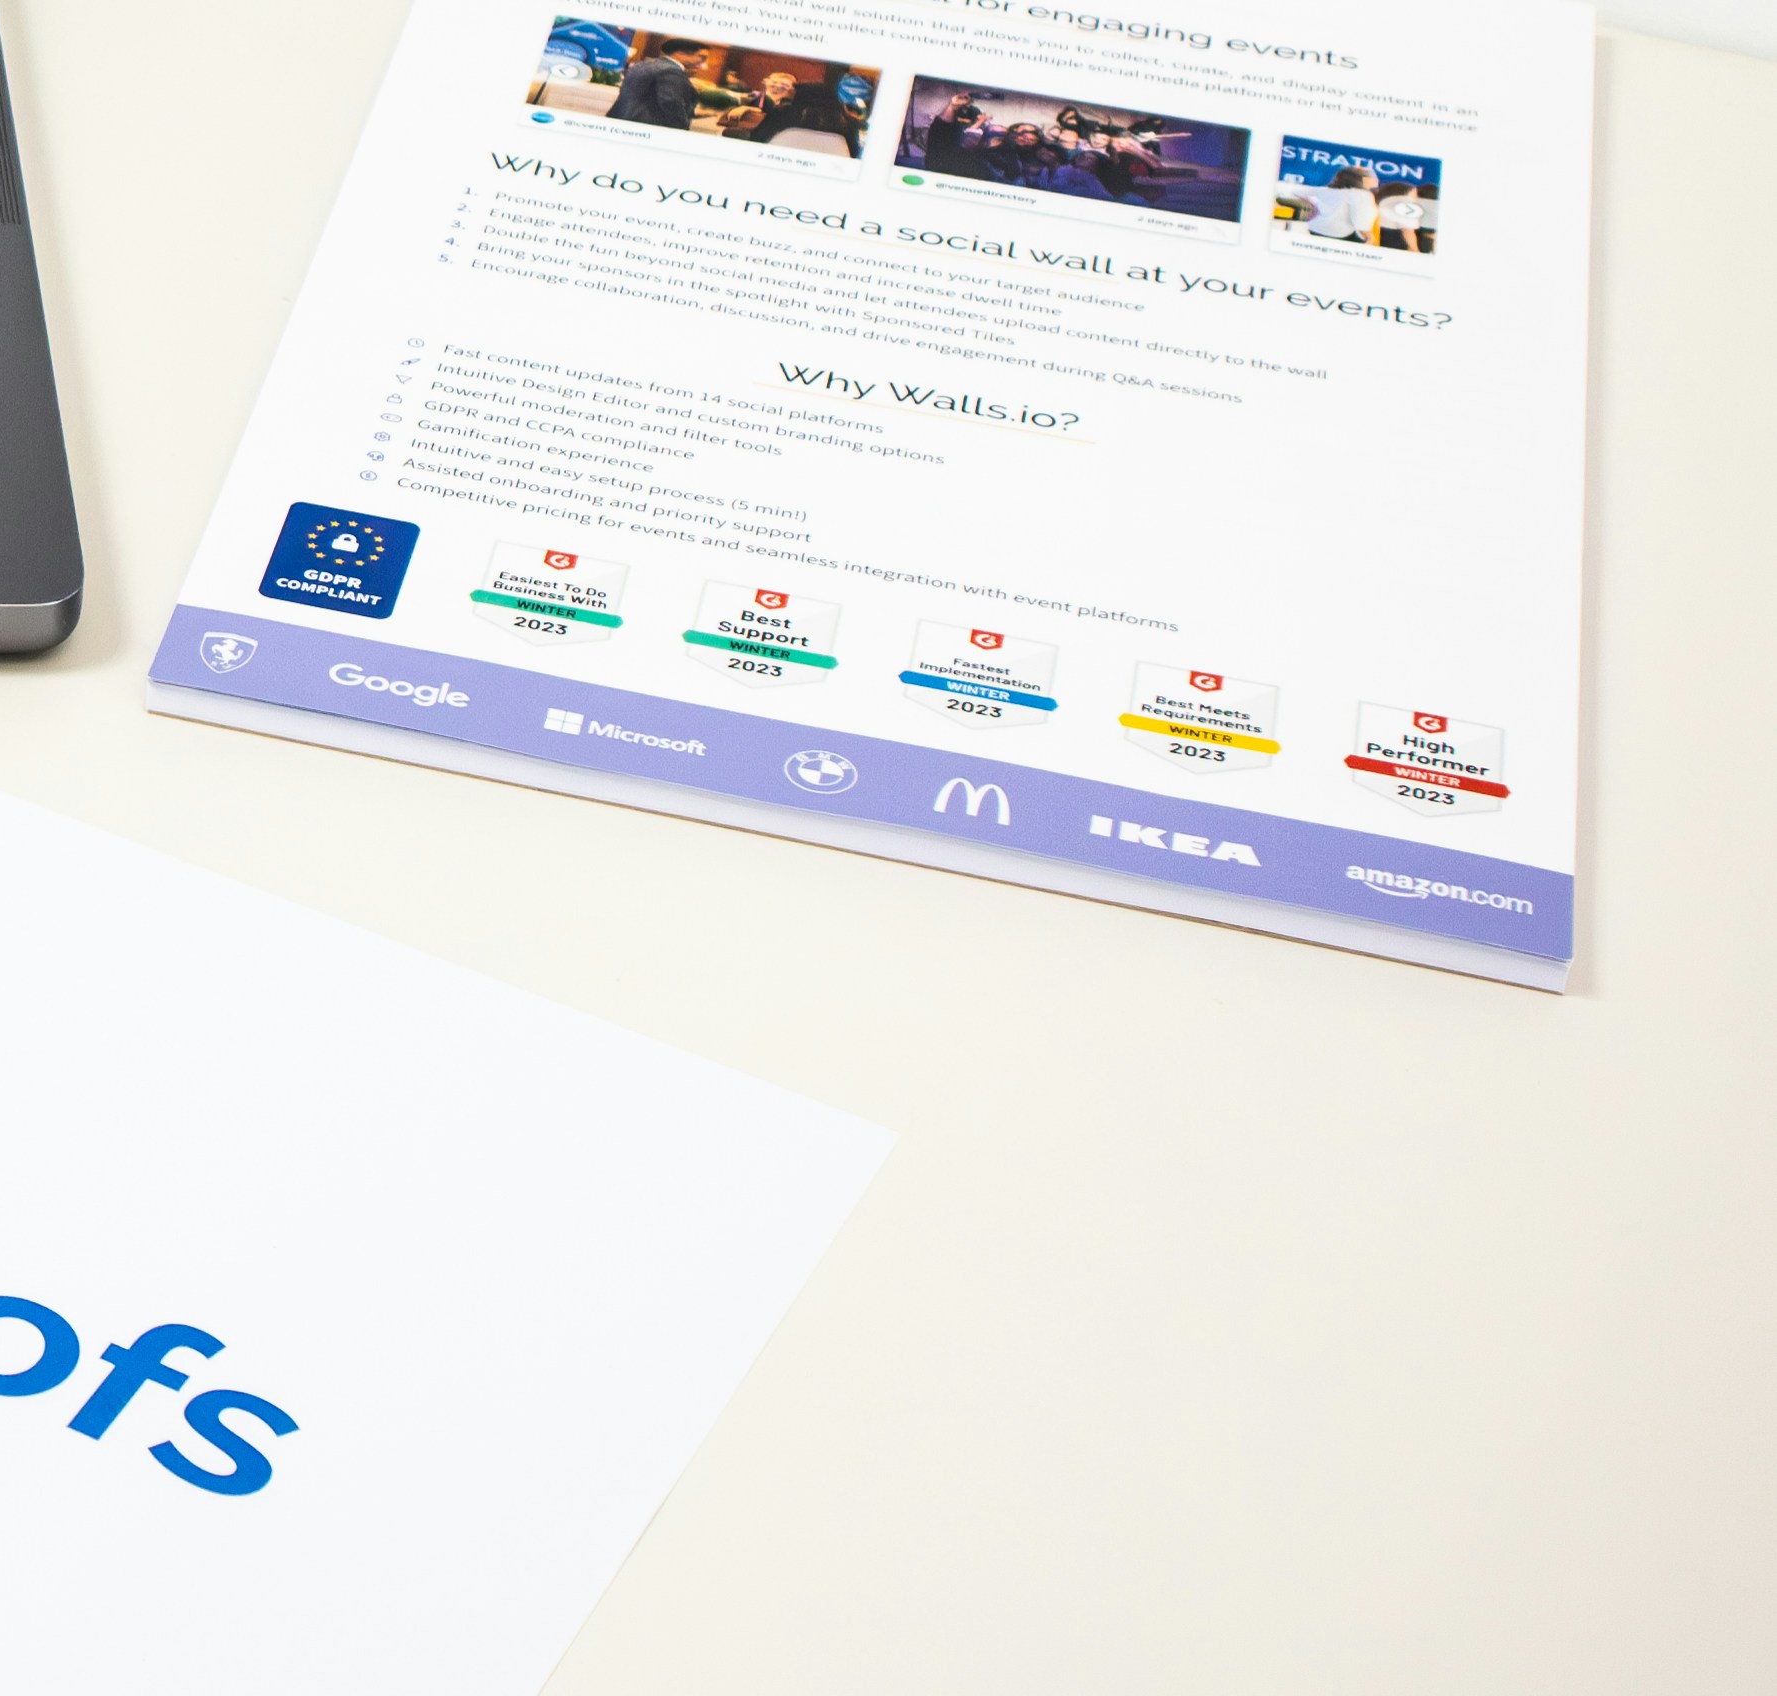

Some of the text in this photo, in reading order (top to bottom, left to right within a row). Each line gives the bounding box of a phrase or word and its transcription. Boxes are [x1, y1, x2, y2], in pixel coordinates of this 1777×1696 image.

[1028, 6, 1212, 50] engaging
[1226, 39, 1358, 70] events
[491, 150, 1453, 330] Why do you need a social wall at your events?
[443, 343, 884, 434] Fast content updates from 14 social platforms
[778, 361, 1080, 432] Why Walls.io?
[430, 380, 782, 456] Powerful moderation and filter tools
[437, 362, 945, 465] Intuitive Design Editor and custom branding options
[424, 400, 695, 460] GDPR and CCPA compliance
[417, 419, 654, 473] Gamification experience
[410, 438, 807, 523] Intuitive and easy setup process (5 min!)
[402, 457, 812, 544] Assisted onboarding and priority support
[396, 477, 1179, 633] Competitive pricing for events and seamless integration with event platforms
[276, 576, 383, 607] COMPLIANT
[304, 568, 363, 590] GDPR
[498, 570, 607, 598] Easiest To Do
[493, 580, 608, 610] Business With
[516, 599, 577, 619] WINTER
[512, 616, 569, 636] 2023
[717, 620, 810, 648] Support
[740, 609, 793, 630] Best
[729, 640, 792, 660] WINTER
[726, 657, 783, 678] 2023
[919, 660, 1042, 693] Implementation
[952, 657, 1011, 677] Fastest
[328, 662, 471, 708] Google
[945, 680, 1012, 703] WINTER
[946, 697, 1003, 719] 2023
[1140, 704, 1263, 735] Requirements
[1154, 695, 1251, 721] Best Meets
[587, 719, 707, 757] Microsoft
[1168, 724, 1234, 745] WINTER
[1402, 734, 1456, 756] High
[1168, 741, 1227, 763] 2023
[1366, 741, 1491, 777] Performer
[1394, 765, 1462, 788] WINTER
[1396, 784, 1456, 806] 2023
[1088, 814, 1263, 868] IKEA
[1345, 864, 1535, 916] amazon.com
